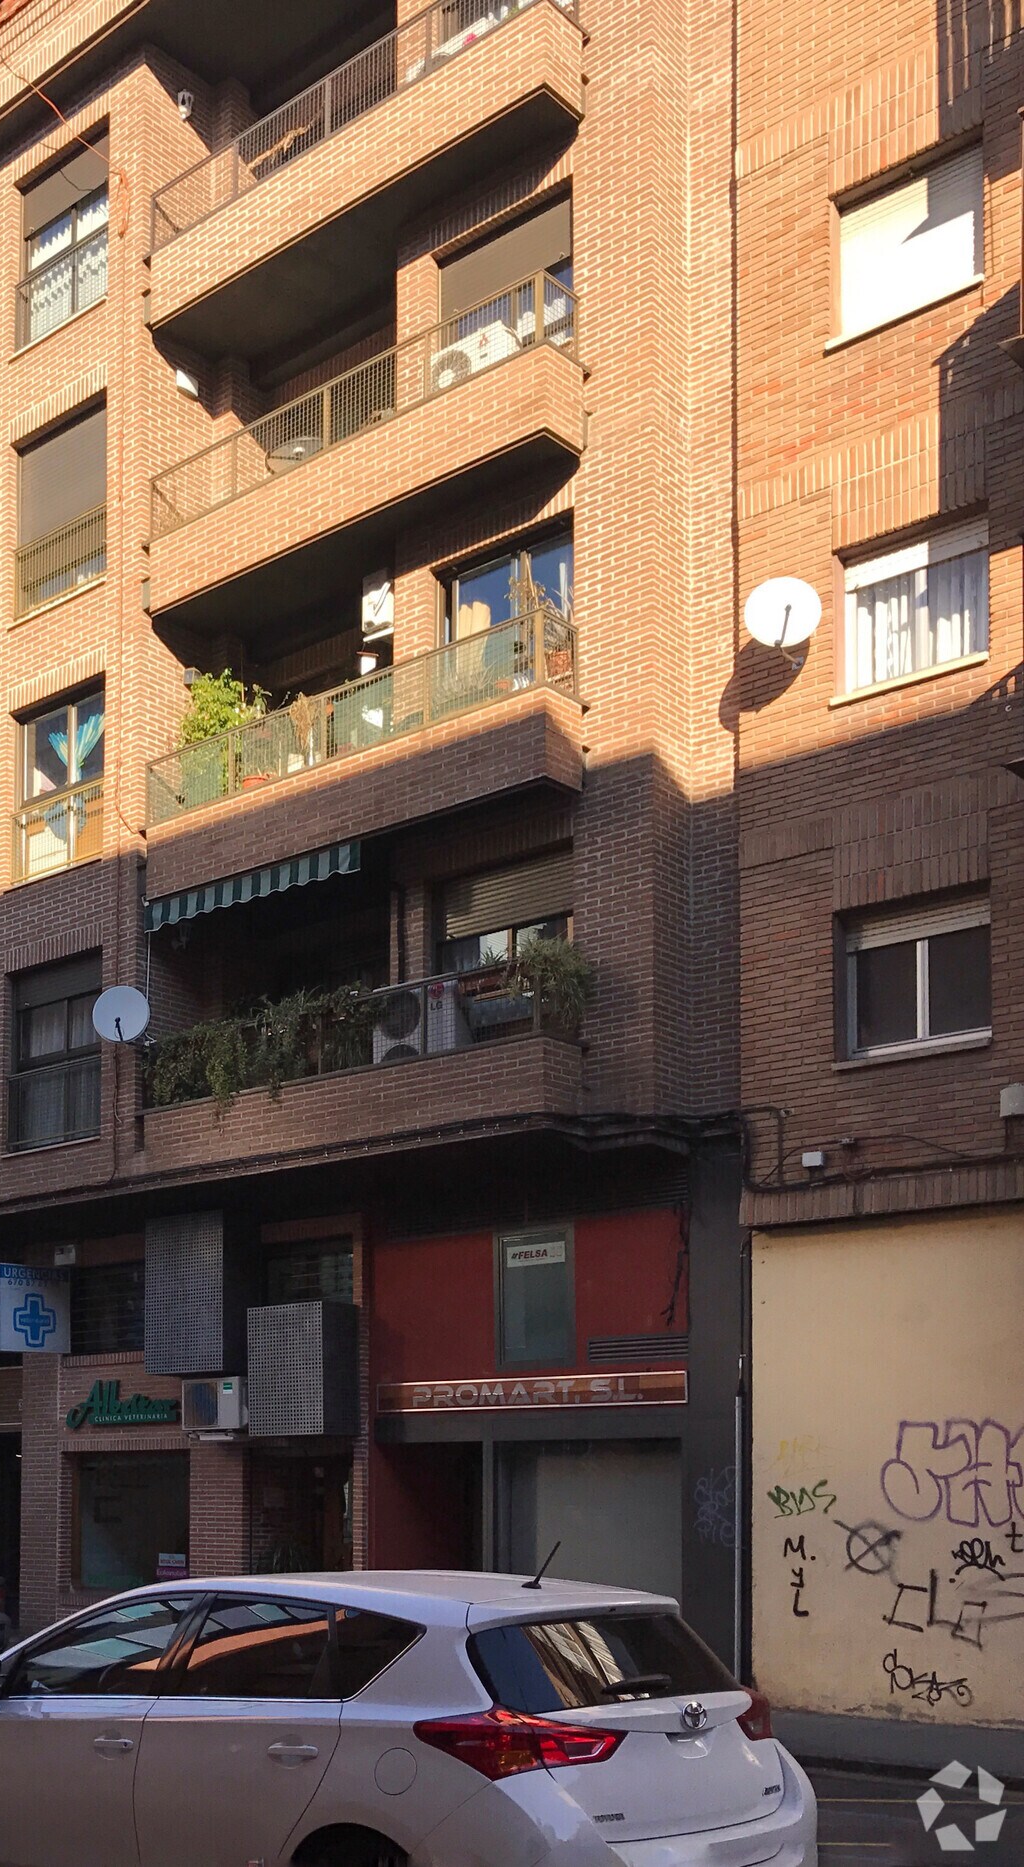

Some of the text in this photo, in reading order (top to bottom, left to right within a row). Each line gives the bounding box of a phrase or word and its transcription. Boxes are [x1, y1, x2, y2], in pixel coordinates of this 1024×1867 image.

[430, 1001, 443, 1011] LG
[3, 1267, 65, 1281] URGENCIAS
[590, 1377, 644, 1401] S.L.
[124, 1413, 168, 1421] VETERINARIA
